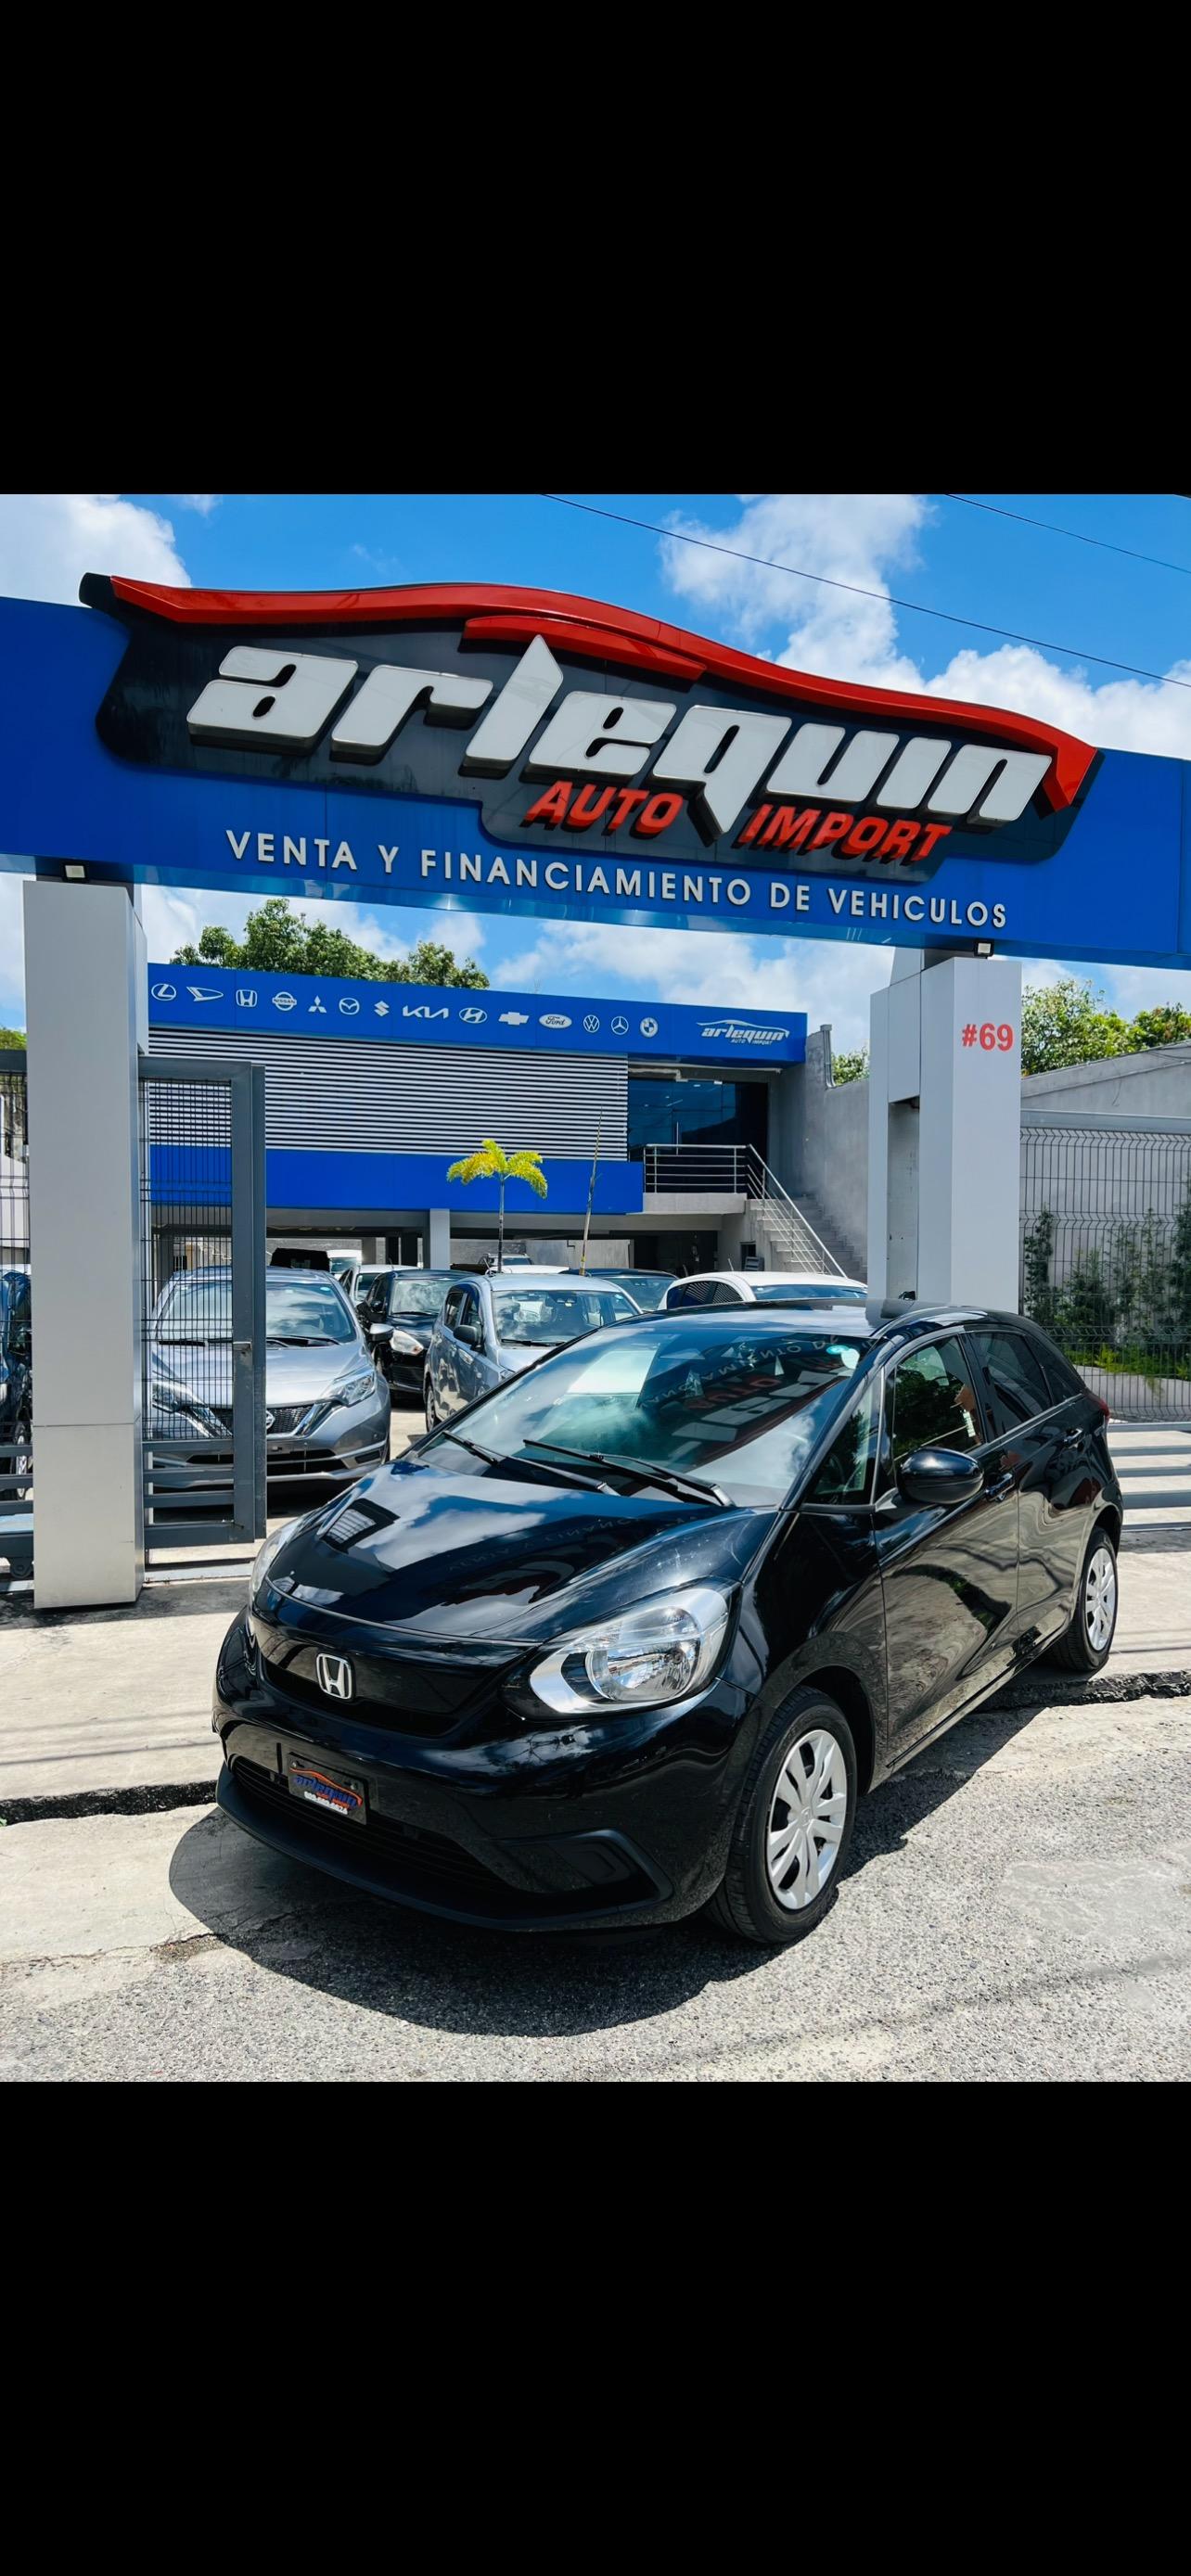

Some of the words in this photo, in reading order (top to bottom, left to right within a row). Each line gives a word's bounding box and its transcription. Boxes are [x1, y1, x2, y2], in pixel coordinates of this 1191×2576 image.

[186, 635, 1052, 833] arlequin
[525, 781, 684, 835] AUTO
[738, 804, 952, 861] IMPORT
[225, 830, 358, 871] VENTA
[378, 845, 400, 874] Y
[421, 849, 751, 908] FINANCIAMIENTO
[770, 881, 811, 912] DE
[828, 888, 1007, 928] VEHICULOS
[701, 1024, 785, 1043] arlequin
[961, 1023, 1013, 1052] #69
